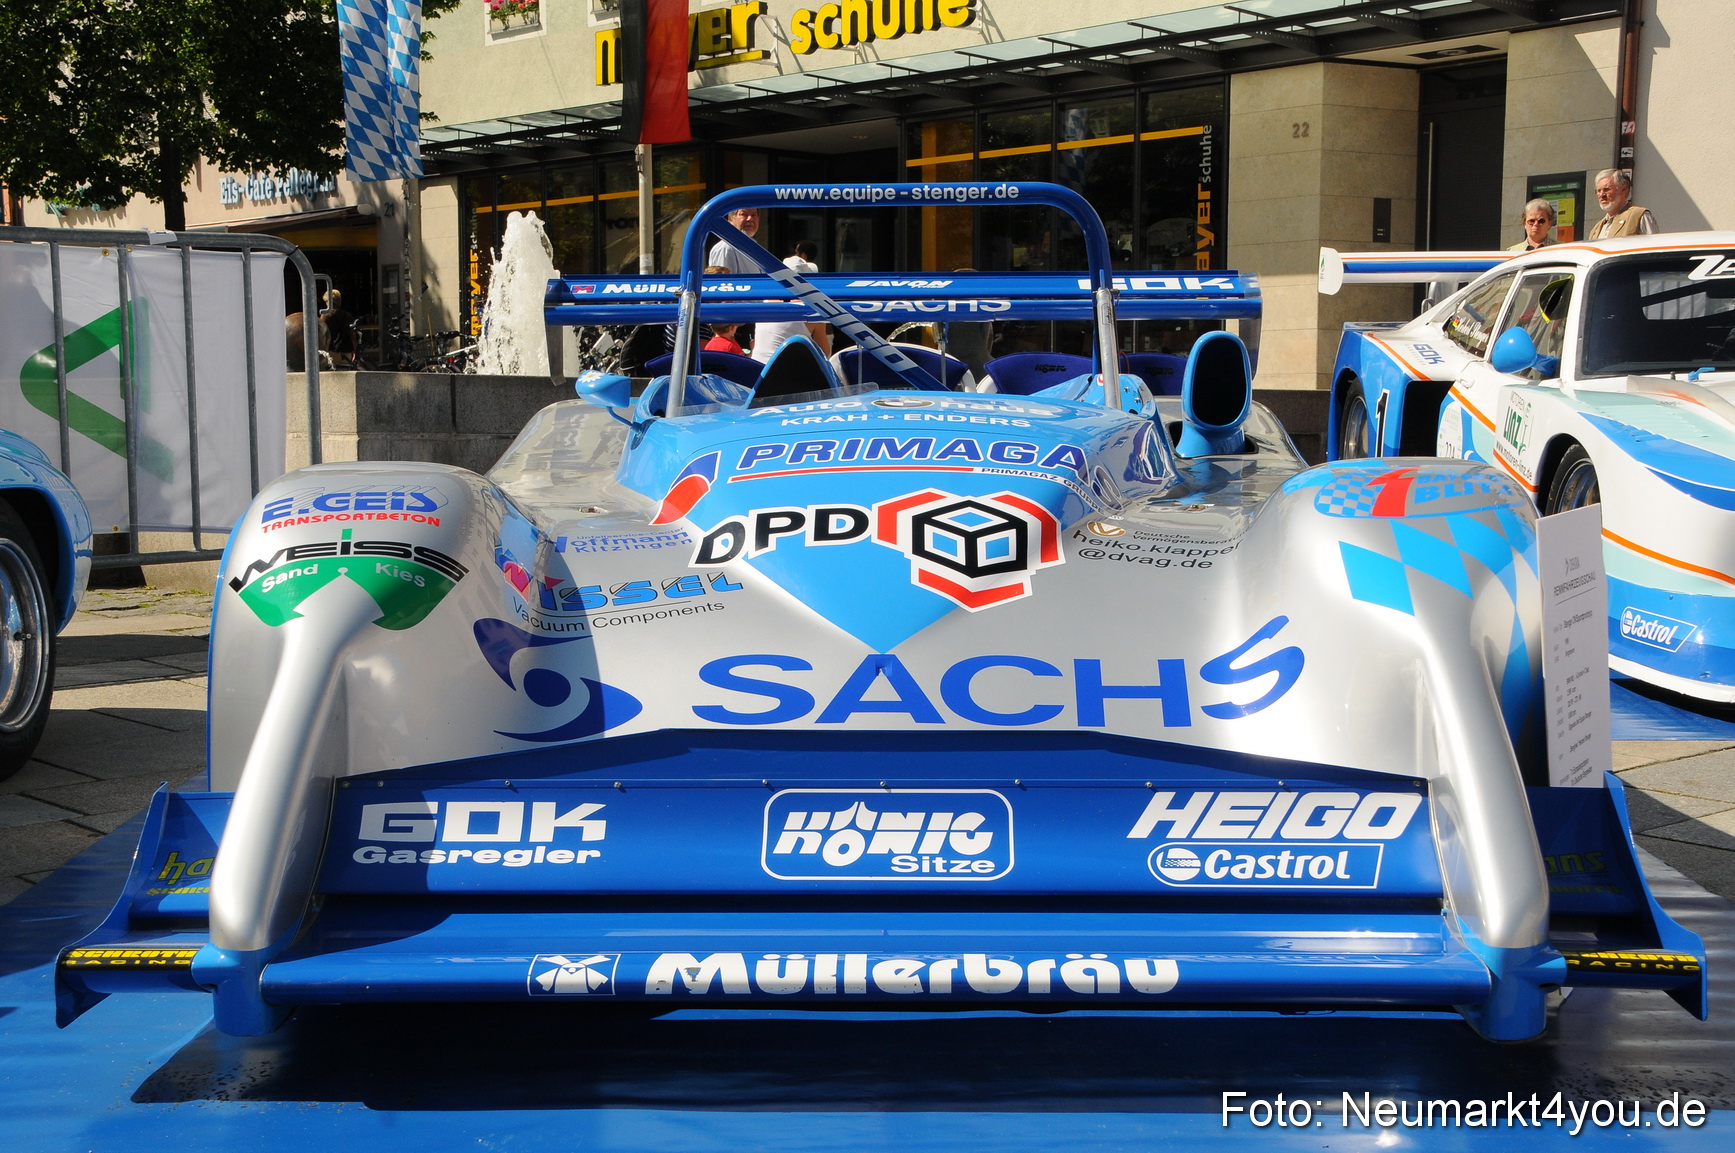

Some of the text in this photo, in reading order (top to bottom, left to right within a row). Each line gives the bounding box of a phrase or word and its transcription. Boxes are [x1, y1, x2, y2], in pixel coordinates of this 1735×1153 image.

[1292, 122, 1310, 138] 22
[1199, 124, 1212, 183] schuhe
[768, 269, 919, 372] HEIGO
[850, 300, 1012, 312] SACHS
[781, 413, 868, 426] KRAH
[904, 413, 1032, 428] ENDERS
[1376, 389, 1394, 458] 1
[1366, 466, 1421, 517] 1
[261, 513, 441, 534] TRANSPORTBETON
[698, 504, 871, 567] DPD
[1134, 530, 1191, 539] Deutsche
[575, 539, 693, 553] Kitzingen
[1078, 548, 1213, 569] @dvag.de
[261, 562, 425, 593] Sand Kies
[592, 600, 725, 629] Components
[1631, 613, 1679, 645] Castrol
[690, 614, 1305, 728] SACHS
[358, 801, 607, 843] GOK
[1127, 791, 1423, 840] HEIGO
[352, 846, 602, 868] Gasregler
[890, 855, 996, 873] Sitze
[1204, 848, 1351, 881] Castrol
[645, 953, 1180, 995] Müllerbräu
